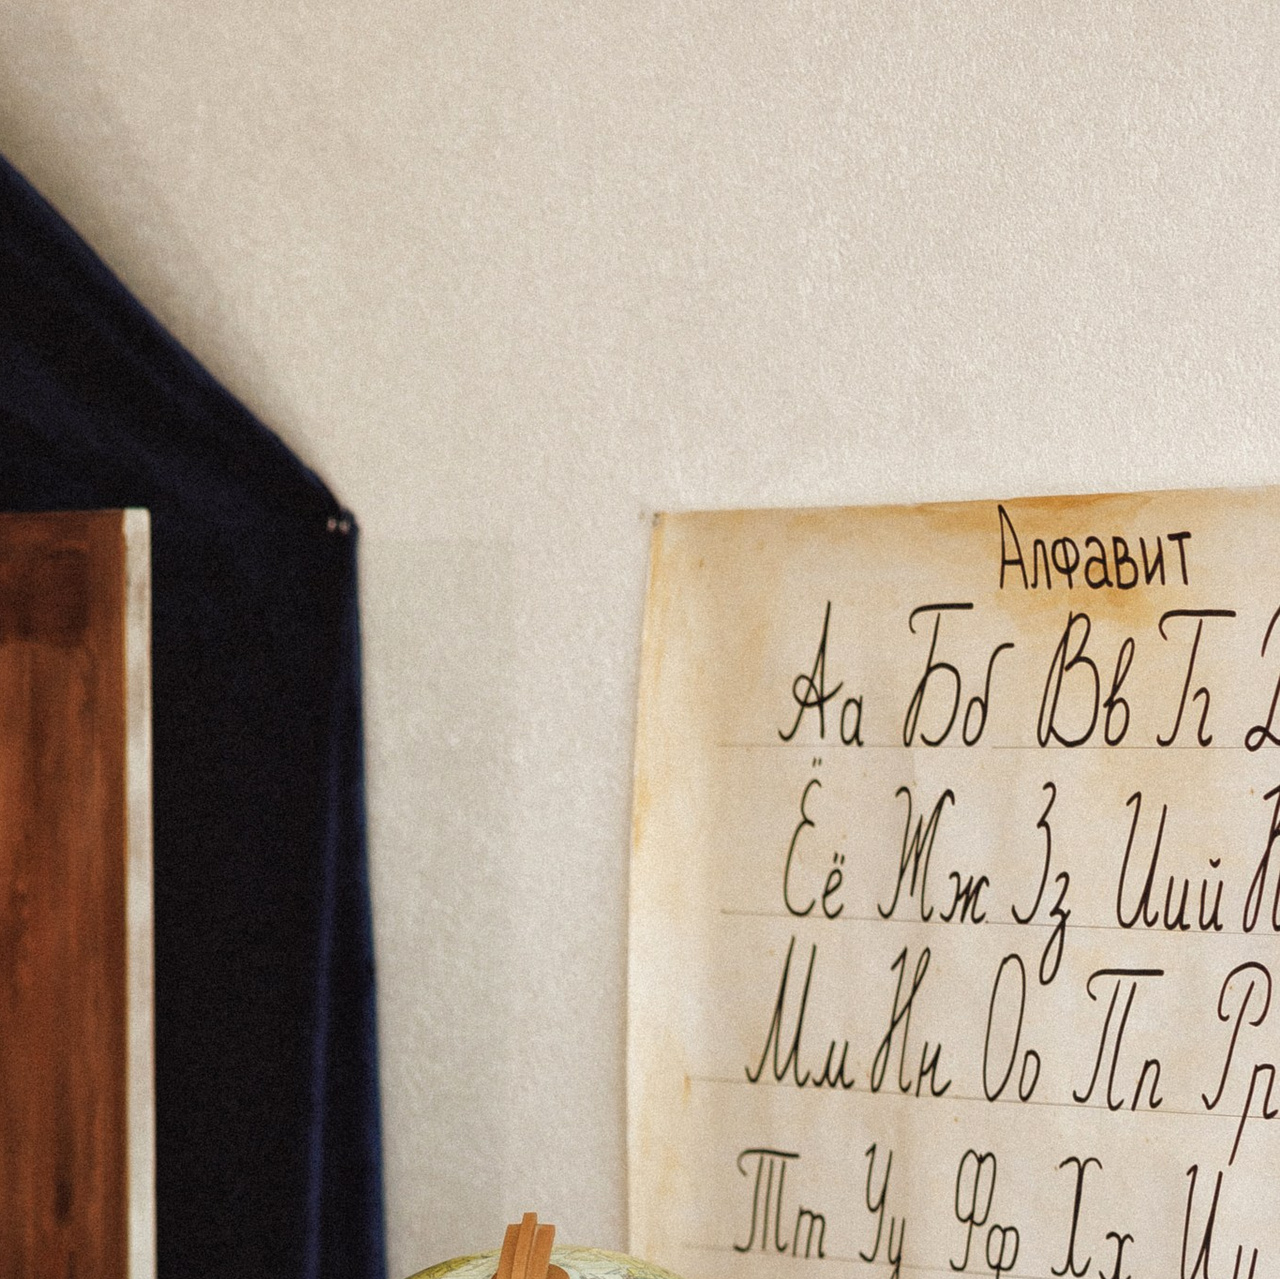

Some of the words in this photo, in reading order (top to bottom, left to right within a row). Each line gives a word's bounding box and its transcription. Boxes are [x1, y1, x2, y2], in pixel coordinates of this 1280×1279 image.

[997, 504, 1192, 590] Алфавит
[778, 601, 864, 747] Аа
[903, 602, 1015, 748] Бб
[1037, 611, 1135, 748] Вв
[784, 758, 845, 920] Ёё
[877, 786, 990, 925] Жж
[1009, 781, 1071, 991] Зз
[746, 936, 855, 1090] Мм
[870, 949, 952, 1098] Нн
[983, 951, 1046, 1103] Оо
[1072, 968, 1164, 1112] Пп
[1201, 961, 1280, 1166] Рр
[734, 1148, 826, 1259] Тт
